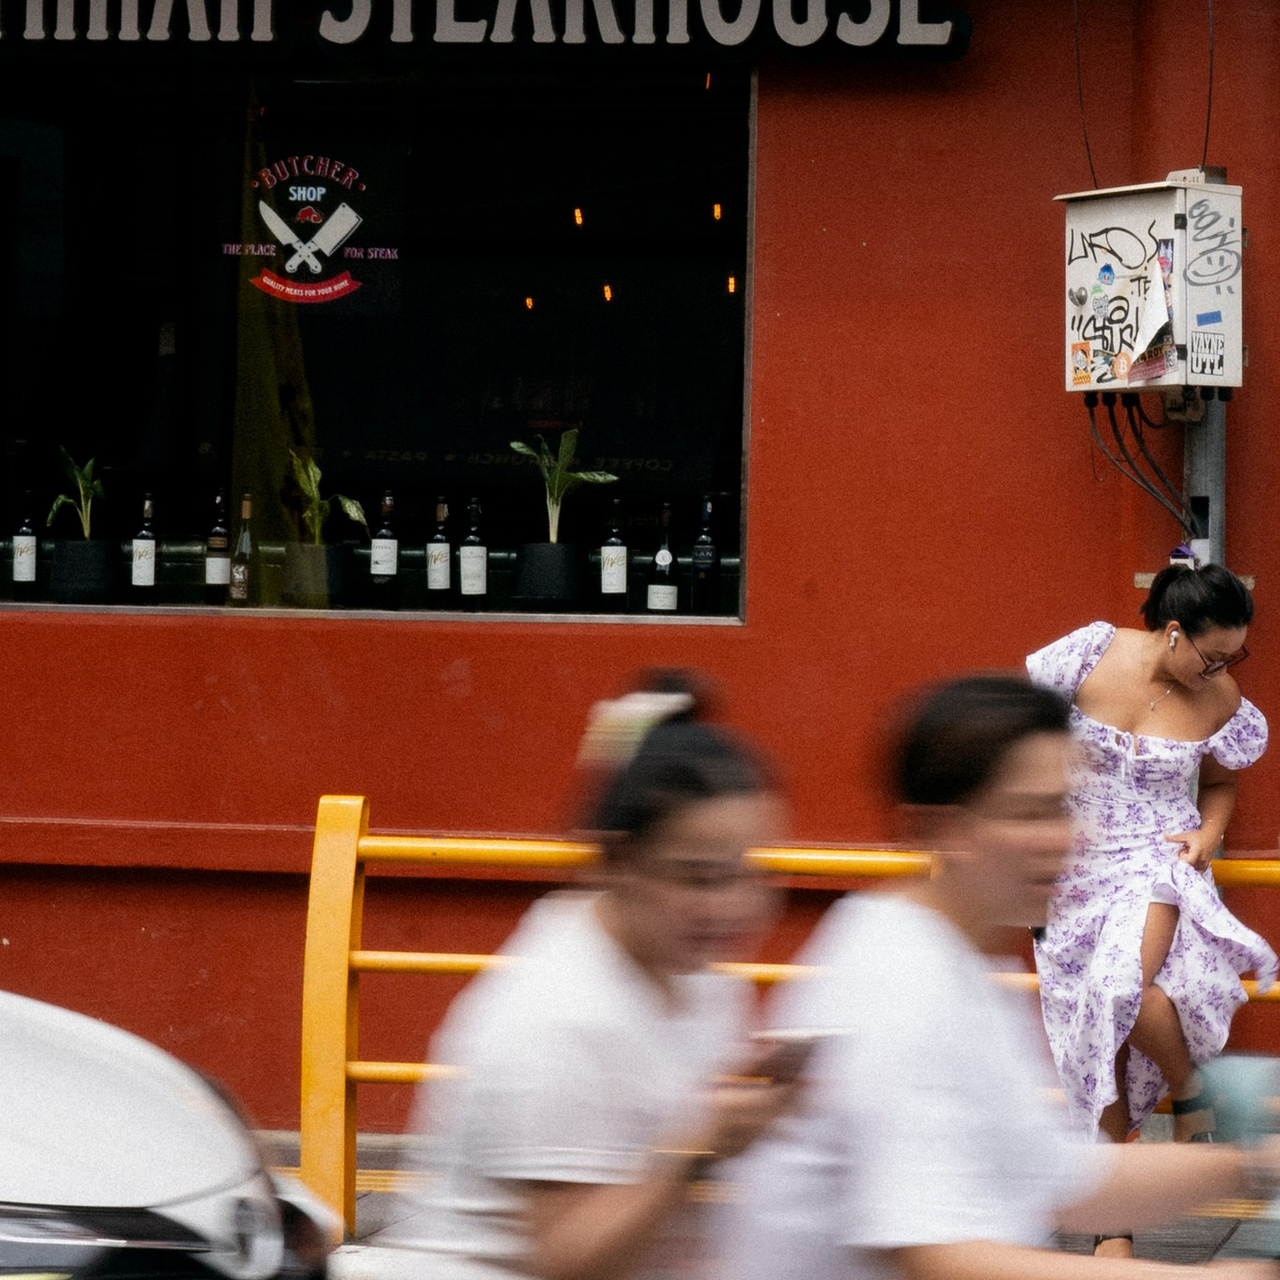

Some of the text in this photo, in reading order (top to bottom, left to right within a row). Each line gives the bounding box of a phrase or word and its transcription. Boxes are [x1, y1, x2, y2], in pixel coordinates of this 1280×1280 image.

[258, 155, 359, 189] BUTCHER
[289, 186, 327, 202] SHOP
[222, 243, 399, 260] THE PLACE FOR STEAK
[262, 276, 286, 292] QUALITY
[285, 287, 304, 297] MEATS
